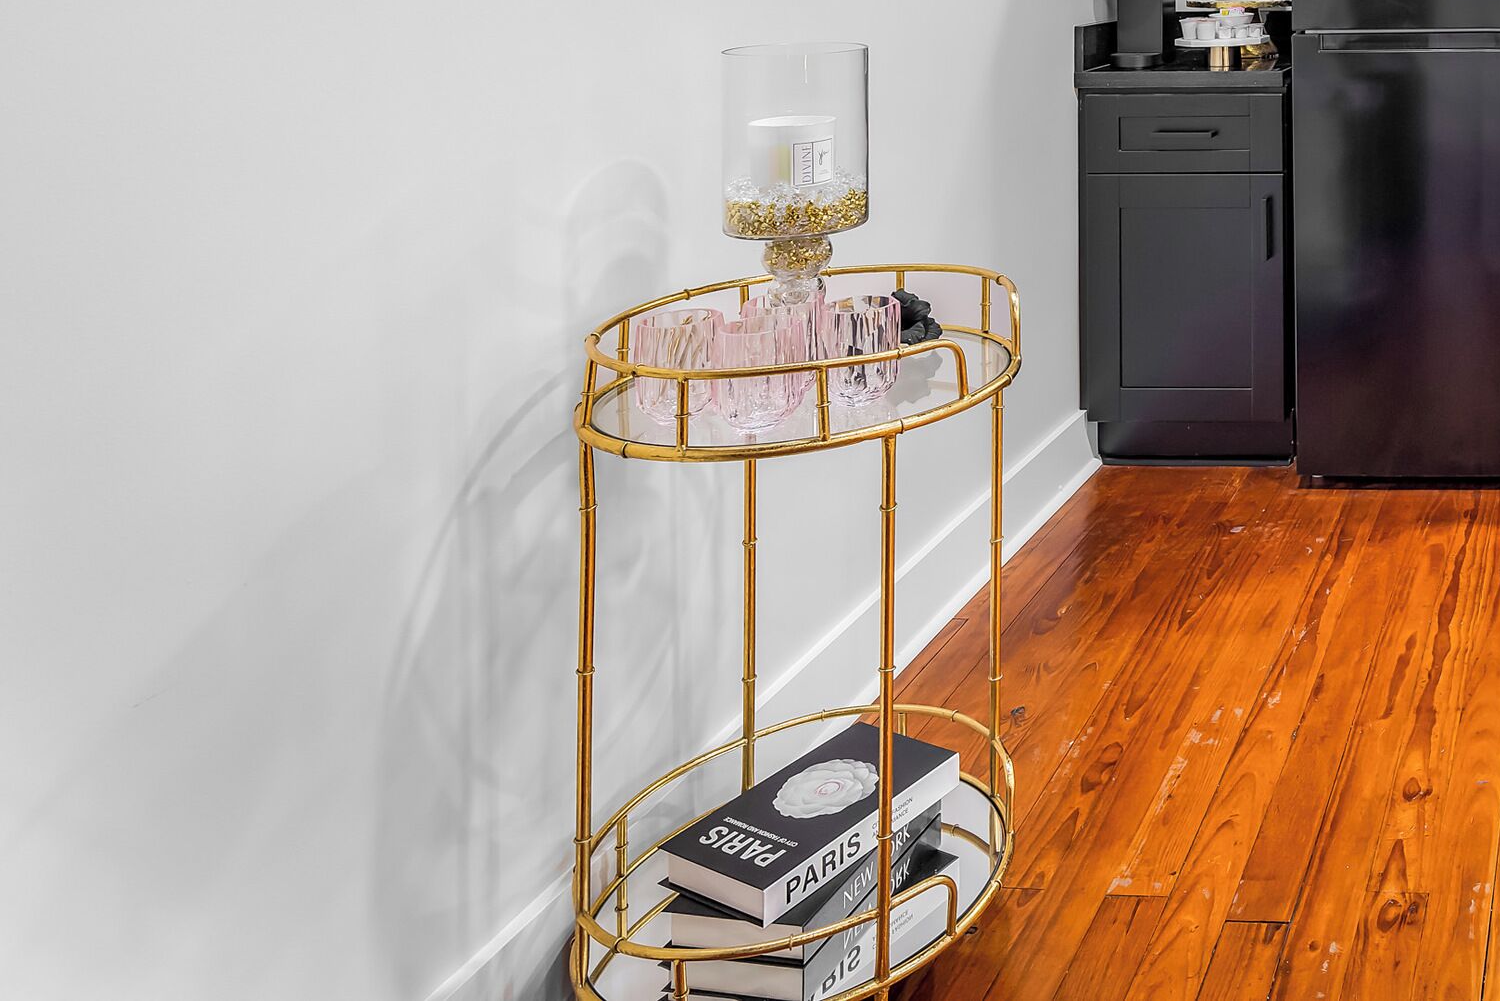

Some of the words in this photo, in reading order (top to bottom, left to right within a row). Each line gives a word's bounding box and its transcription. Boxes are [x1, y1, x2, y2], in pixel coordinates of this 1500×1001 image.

[801, 145, 812, 183] DIVINE
[699, 826, 787, 867] PARIS
[786, 832, 861, 905] PARIS
[843, 861, 875, 909] NEW
[890, 823, 911, 857] RK
